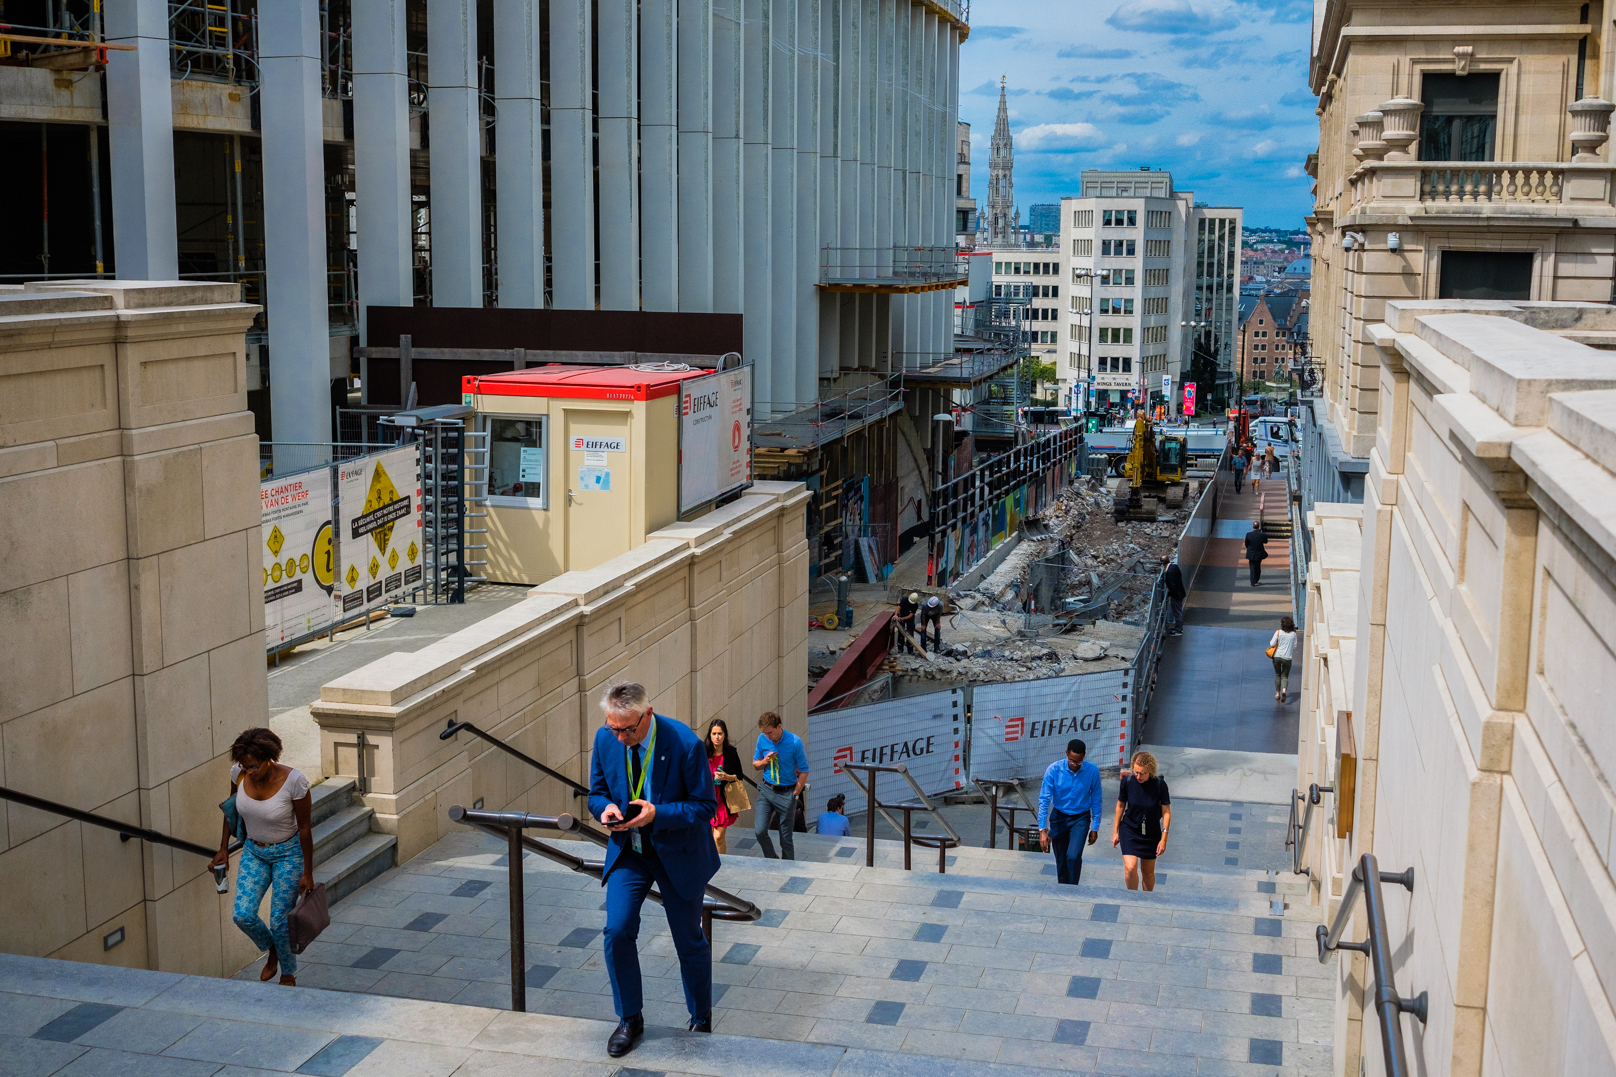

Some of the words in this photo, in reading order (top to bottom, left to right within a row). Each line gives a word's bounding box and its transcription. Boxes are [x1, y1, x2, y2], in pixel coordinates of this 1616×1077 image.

[692, 391, 719, 414] EIFFAGE
[586, 440, 621, 450] EIFFAGE
[265, 498, 279, 509] VAN
[281, 495, 289, 505] DE
[291, 490, 309, 502] WERF
[270, 482, 302, 497] CHANTIER
[1029, 712, 1103, 739] EIFFAGE
[860, 735, 935, 763] EIFFAGE
